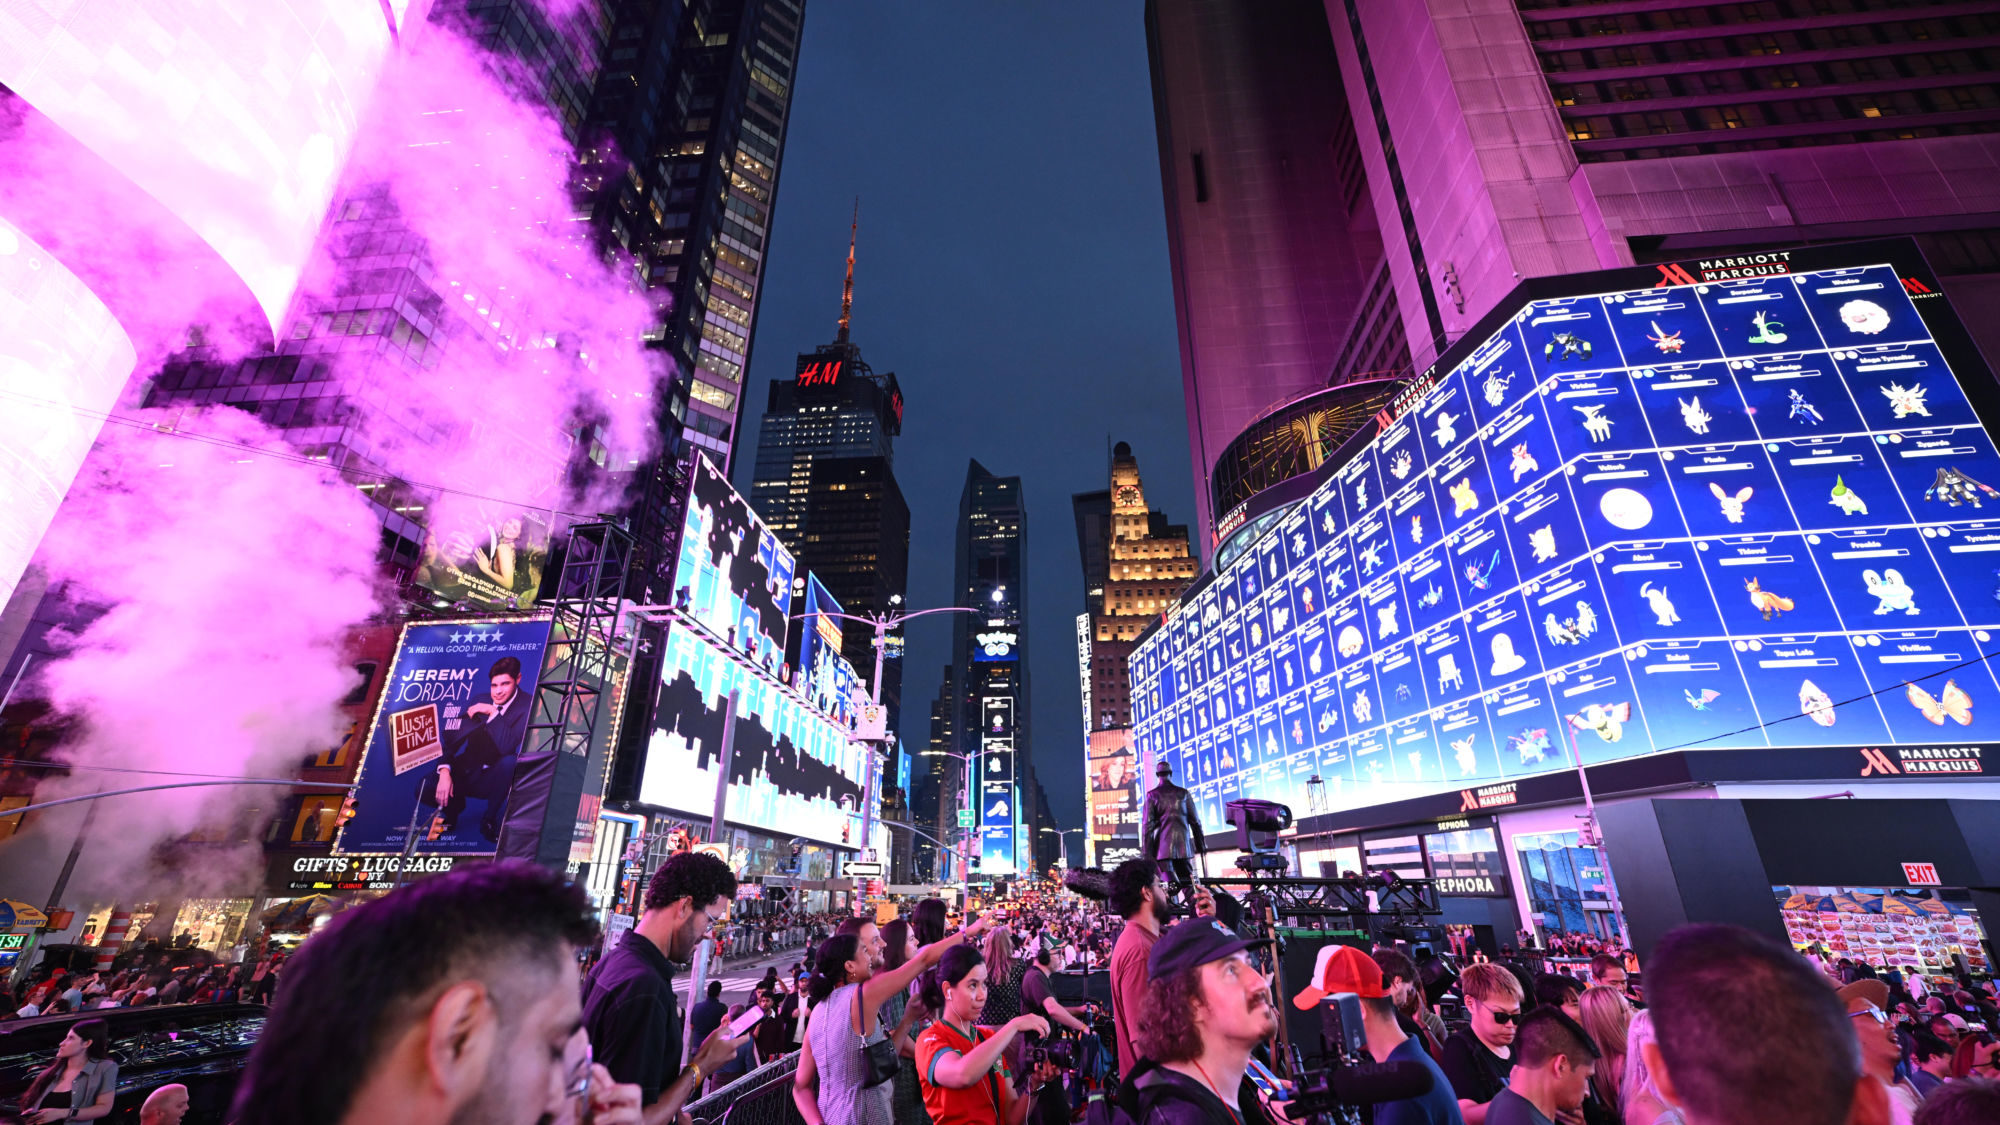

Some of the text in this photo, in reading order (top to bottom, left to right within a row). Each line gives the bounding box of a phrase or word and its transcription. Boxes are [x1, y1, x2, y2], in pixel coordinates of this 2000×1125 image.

[1700, 252, 1790, 270] MARRIOTT
[1705, 264, 1786, 281] MARQUIS
[1909, 292, 1943, 300] MARRIOTT
[798, 360, 842, 387] H&M
[1394, 365, 1436, 408] MARRIOTT
[1396, 380, 1434, 417] MARQUIS
[1218, 502, 1248, 530] MARRIOTT
[1220, 514, 1245, 539] MARQUIS
[415, 645, 444, 653] HELLUVA
[446, 645, 471, 653] GOOD
[472, 644, 487, 652] TIME
[402, 668, 479, 681] JEREMY
[395, 682, 473, 702] JORDAN
[398, 714, 426, 735] JUST
[1898, 748, 1981, 759] MARRIOTT
[1905, 761, 1979, 771] MARQUIS
[1477, 783, 1517, 797] MARRIOTT
[1480, 794, 1516, 806] MARQUIS
[1096, 813, 1119, 825] THE
[1438, 820, 1470, 831] SEPHORA
[293, 858, 453, 872] GIFTS LUGGAGE
[367, 872, 385, 881] NY
[1905, 865, 1937, 882] EXIT
[1436, 877, 1495, 893] SEPHORA
